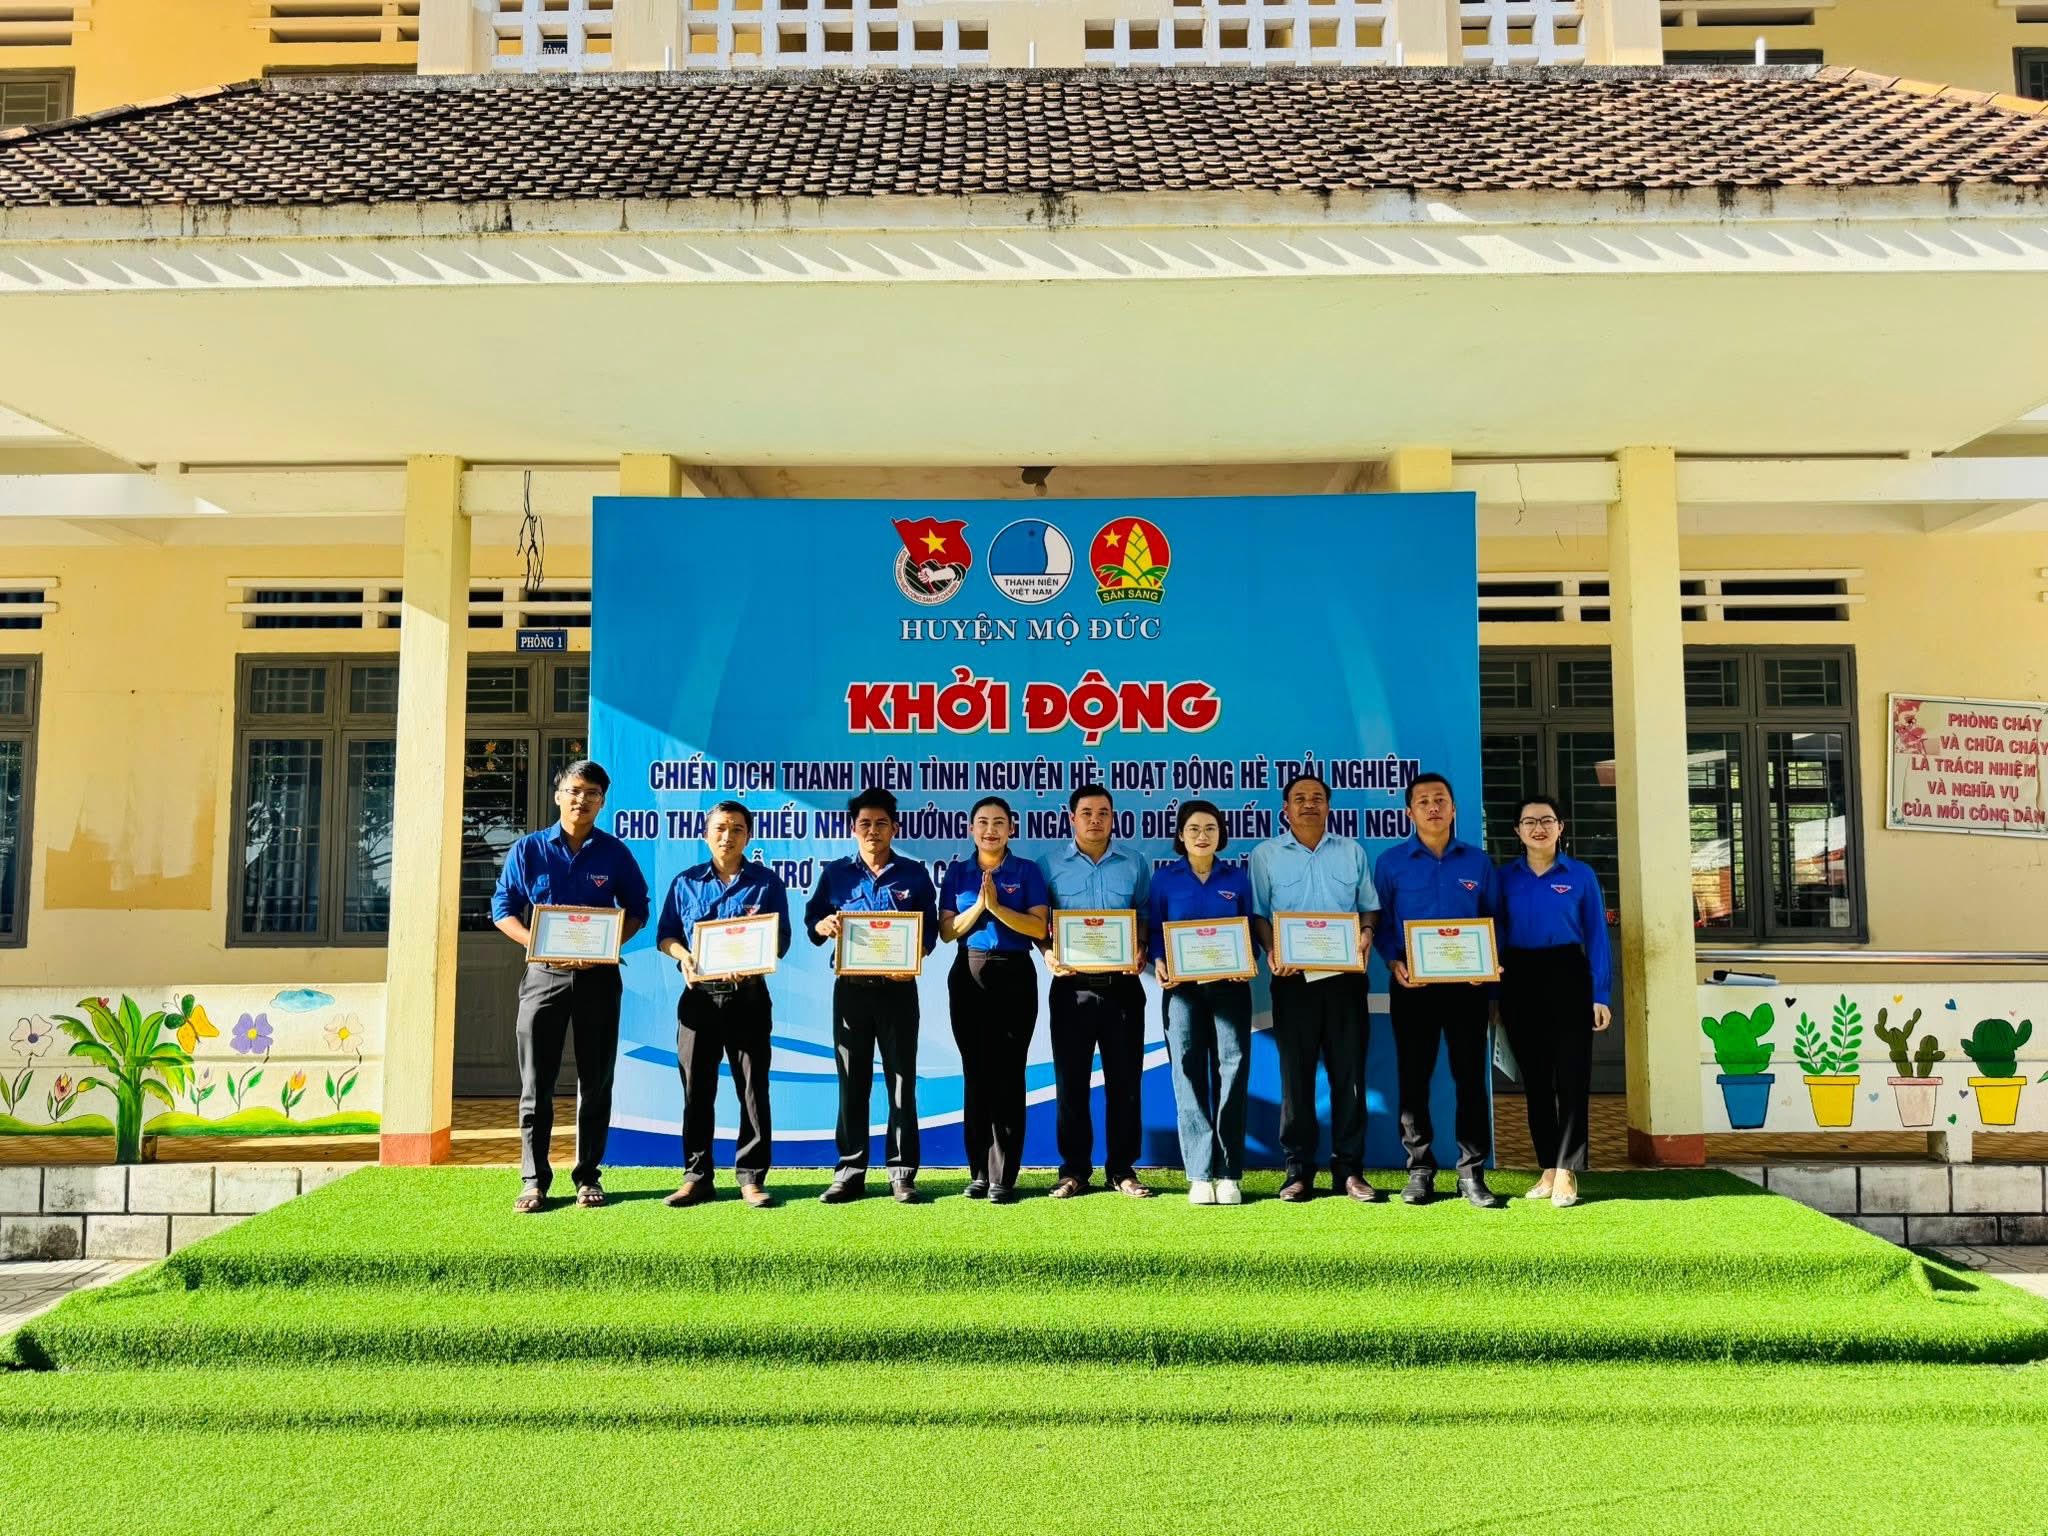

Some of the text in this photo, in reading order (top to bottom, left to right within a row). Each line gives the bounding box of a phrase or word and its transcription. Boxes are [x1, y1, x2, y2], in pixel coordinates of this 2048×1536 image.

[1004, 577, 1059, 586] THANH NIÊN
[520, 634, 563, 648] PHÒNG 1
[900, 612, 1161, 646] HUYỆN MỘ ĐỨC
[846, 665, 1221, 746] KHỞI ĐỘNG
[1948, 711, 2042, 733] PHÒNG CHÁY
[1940, 733, 2048, 756] VÀ CHỮA CHÁY
[650, 752, 717, 791] CHIẾN
[723, 761, 775, 797] DỊCH
[781, 761, 852, 791] THANH
[860, 756, 913, 791] NIÊN
[919, 755, 968, 791] TÌNH
[975, 755, 1064, 797] NGUYỆN
[1111, 760, 1167, 796] HOẠT
[1173, 756, 1233, 796] ĐỘNG
[1240, 755, 1268, 790] HÈ
[1274, 750, 1324, 790] TRẢI
[1331, 754, 1420, 795] NGHIỆM
[1912, 755, 2037, 780] LÀ TRÁCH NHIỆM
[1927, 778, 2019, 802] VÀ NGHĨA VỤ
[614, 810, 660, 840] CHO
[666, 810, 707, 840] THA
[750, 801, 808, 840] THIẾU
[1027, 804, 1072, 840] NGÀ
[1110, 810, 1135, 840] AO
[1142, 800, 1177, 840] ĐIỂ
[1220, 800, 1273, 840] HIẾN
[1903, 797, 2046, 825] CỦA MỖI CÔNG DÂN
